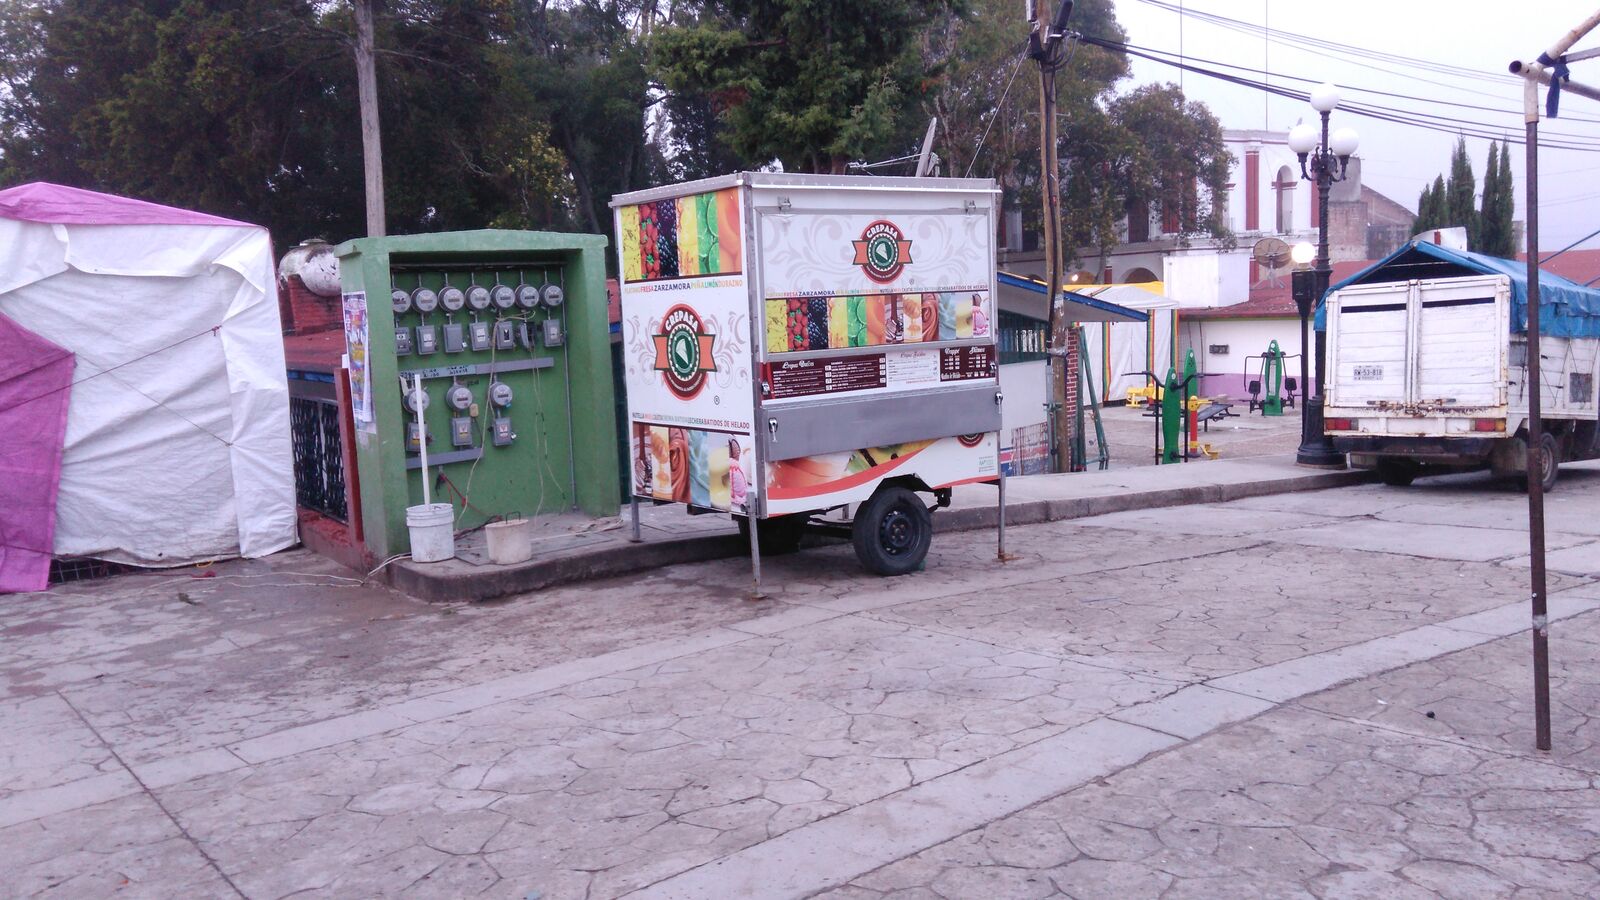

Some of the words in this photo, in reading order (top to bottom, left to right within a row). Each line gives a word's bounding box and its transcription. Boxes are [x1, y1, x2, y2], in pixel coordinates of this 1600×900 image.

[866, 224, 898, 239] CREPASA
[654, 282, 691, 292] ZARZAMORA
[665, 310, 699, 333] CREPASA
